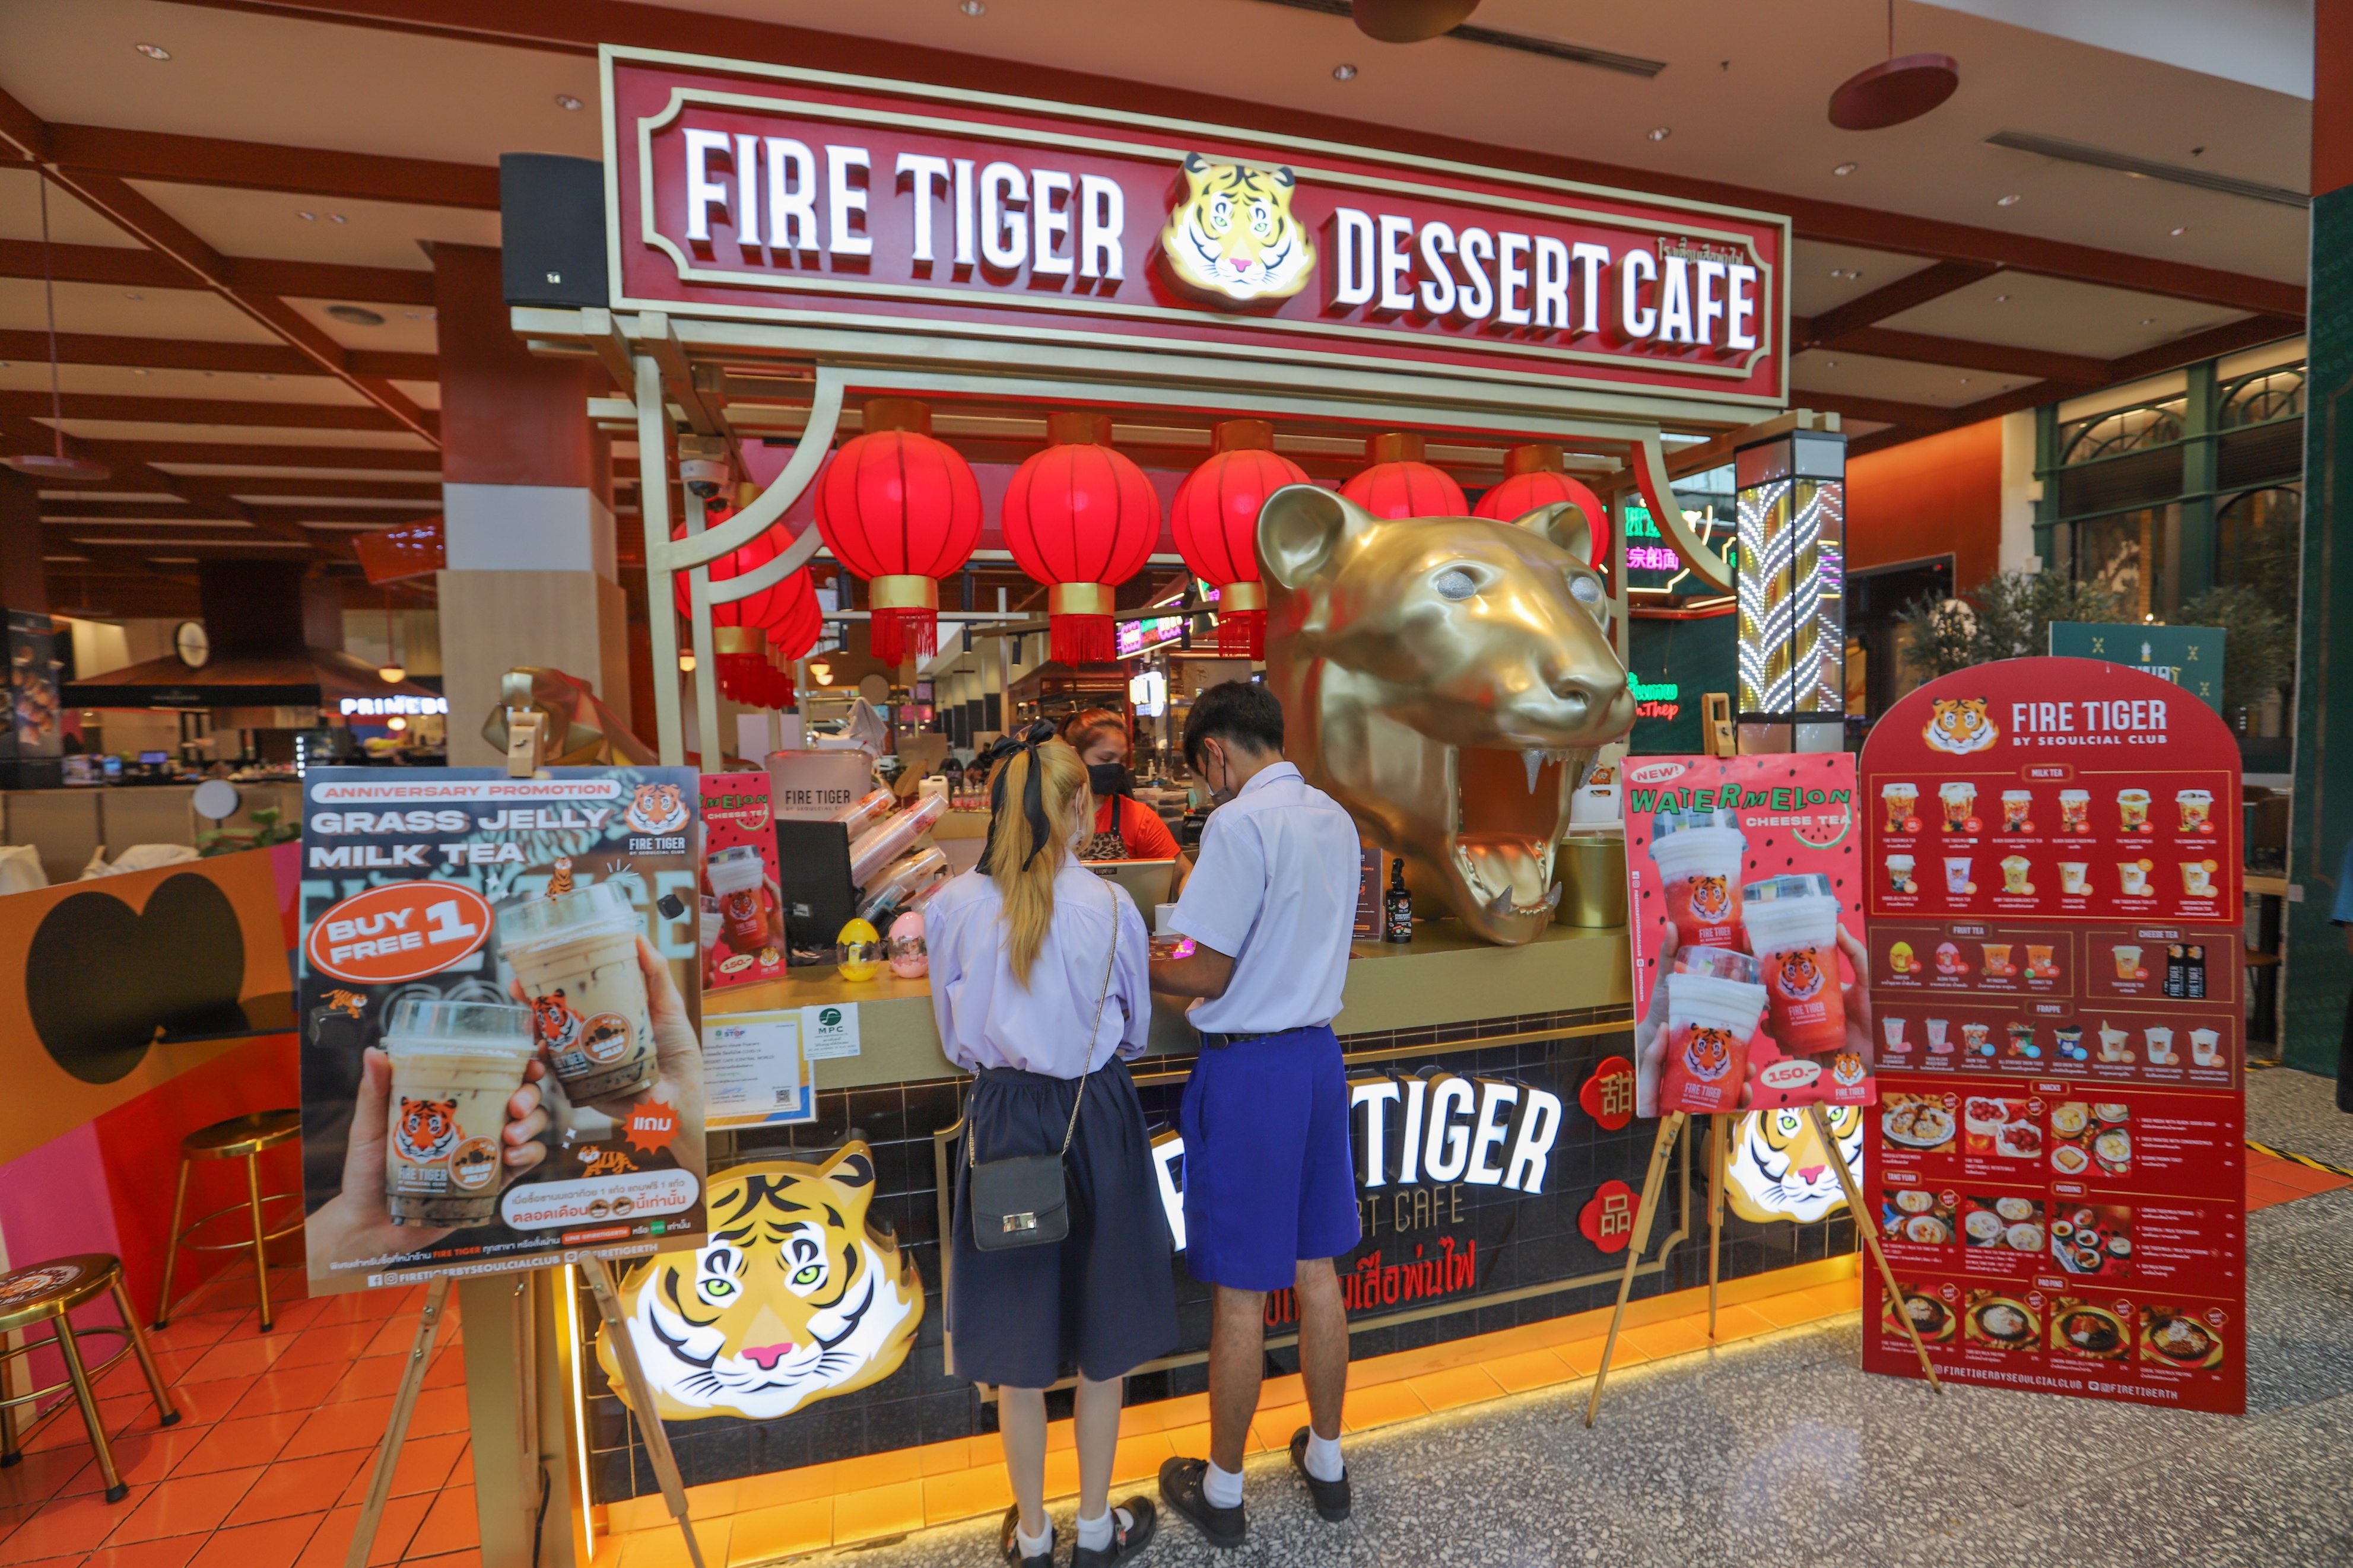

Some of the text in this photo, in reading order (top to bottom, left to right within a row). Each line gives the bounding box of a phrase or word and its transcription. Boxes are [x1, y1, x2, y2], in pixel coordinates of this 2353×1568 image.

[682, 128, 1757, 351] FIRE TIGER DESSERT CAFE
[1625, 546, 1680, 571] 宗船面
[2012, 698, 2167, 734] FIRE TIGER
[2013, 734, 2168, 746] BY SEOULCIAL CLUB
[1637, 765, 1680, 781] NEW!
[324, 784, 611, 798] ANNIVERSARY PROMOTION
[785, 789, 850, 804] FIRE TIGER
[1631, 783, 1852, 815] WATERMELON
[310, 807, 613, 835] GRASS JELLY
[707, 812, 748, 820] CHEESE
[1745, 815, 1852, 828] CHEESE TEA
[629, 837, 685, 851] FIRE TIGER
[309, 842, 527, 869] MILK TEA
[326, 907, 415, 943] BUY
[425, 899, 475, 945] 1
[1952, 925, 1984, 935] FRUIT TEA
[1698, 926, 1731, 939] FIRE TIGER
[2138, 930, 2179, 939] CHEESE TEA
[329, 930, 423, 965] FREE
[2036, 1004, 2061, 1014] FRAPPE
[818, 1026, 844, 1034] MPC
[1768, 1067, 1818, 1083] 150.-
[1600, 1070, 1636, 1117] 甜
[1836, 1086, 1865, 1096] FIRE TIGER
[633, 1116, 672, 1132] แถม
[1351, 1075, 1563, 1195] TIGER
[512, 1204, 588, 1223] ตลอดเดือน
[1395, 1182, 1465, 1233] CAFE
[1600, 1193, 1632, 1238] 品
[433, 1249, 452, 1258] FIRE
[454, 1246, 481, 1257] TIGER
